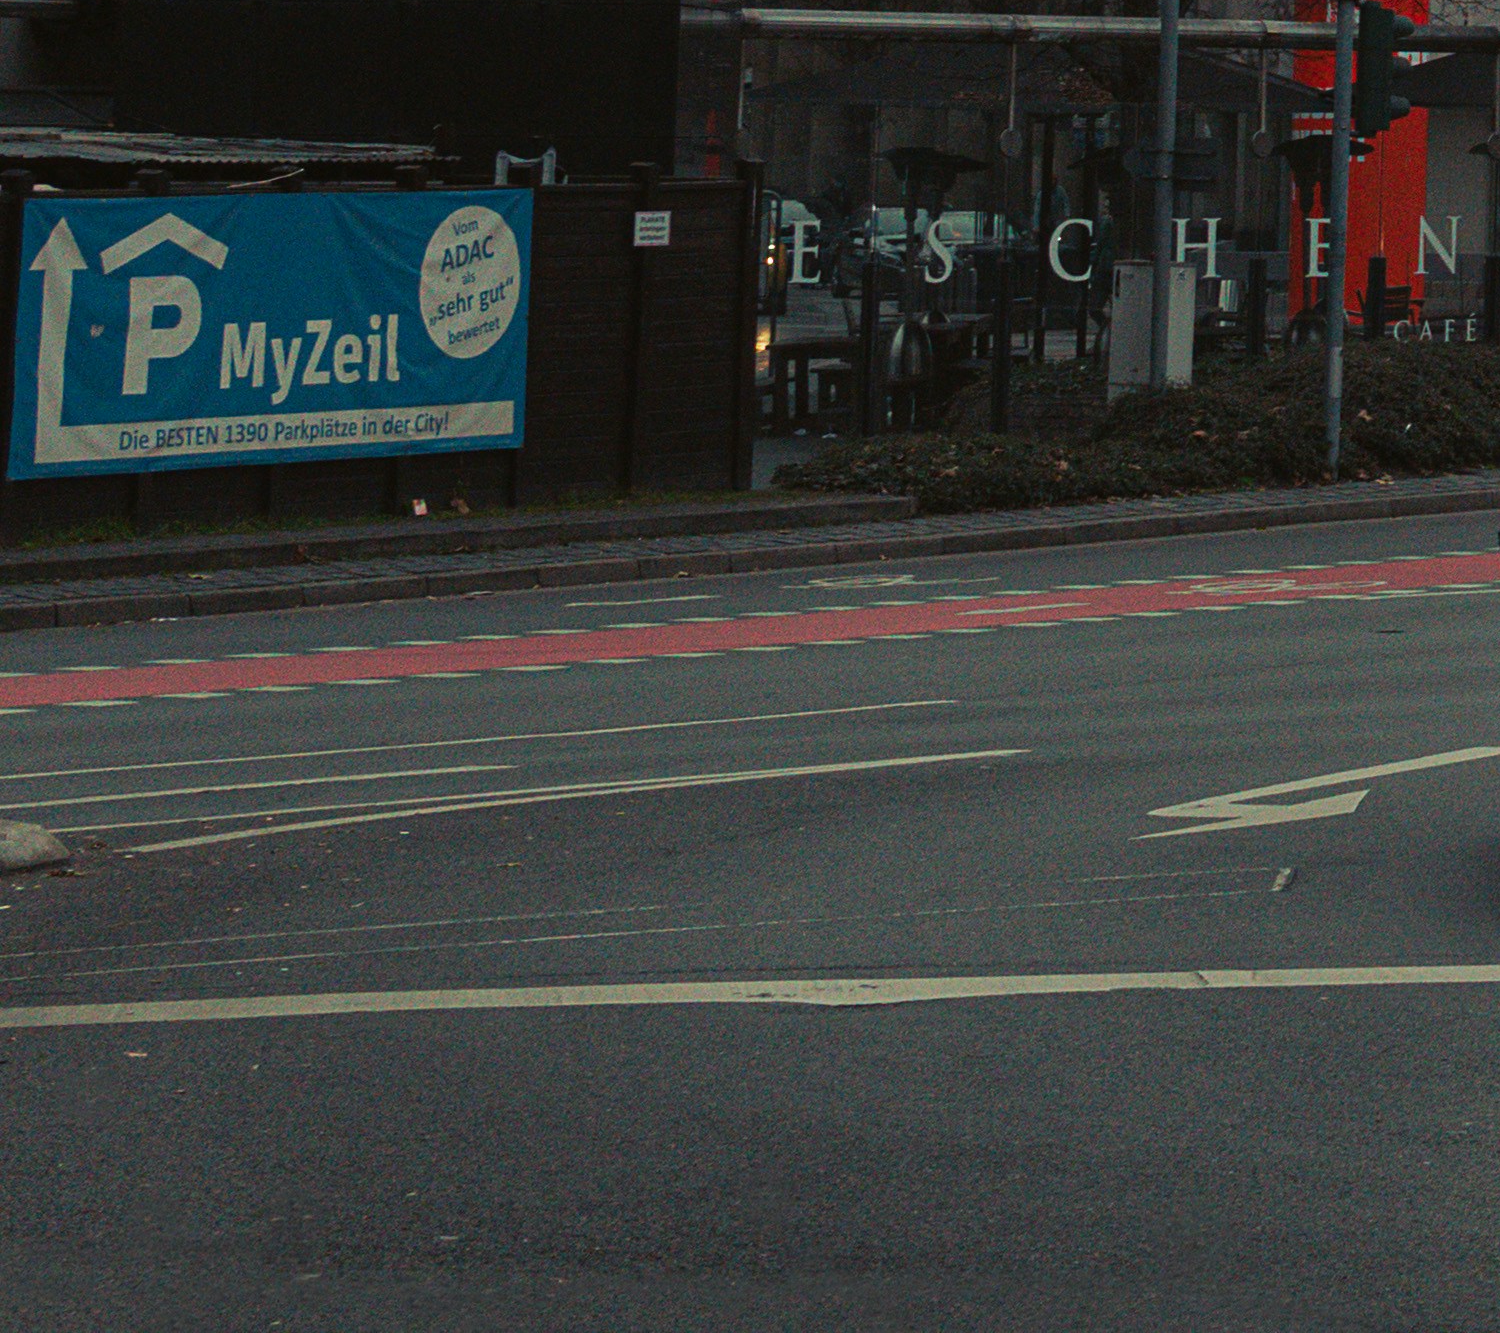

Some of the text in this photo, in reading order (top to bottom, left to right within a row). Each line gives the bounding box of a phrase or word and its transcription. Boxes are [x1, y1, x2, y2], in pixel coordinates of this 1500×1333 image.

[452, 220, 479, 237] Vom
[441, 235, 495, 273] ADAC
[461, 270, 476, 285] als
[429, 293, 474, 327] „sehr
[122, 275, 202, 395] P
[448, 316, 501, 345] bewertet
[1393, 313, 1477, 343] CAFÉ
[220, 314, 400, 406] MyZeil
[119, 411, 449, 451] Die BESTEN 1390 Parkplätze in der City!
